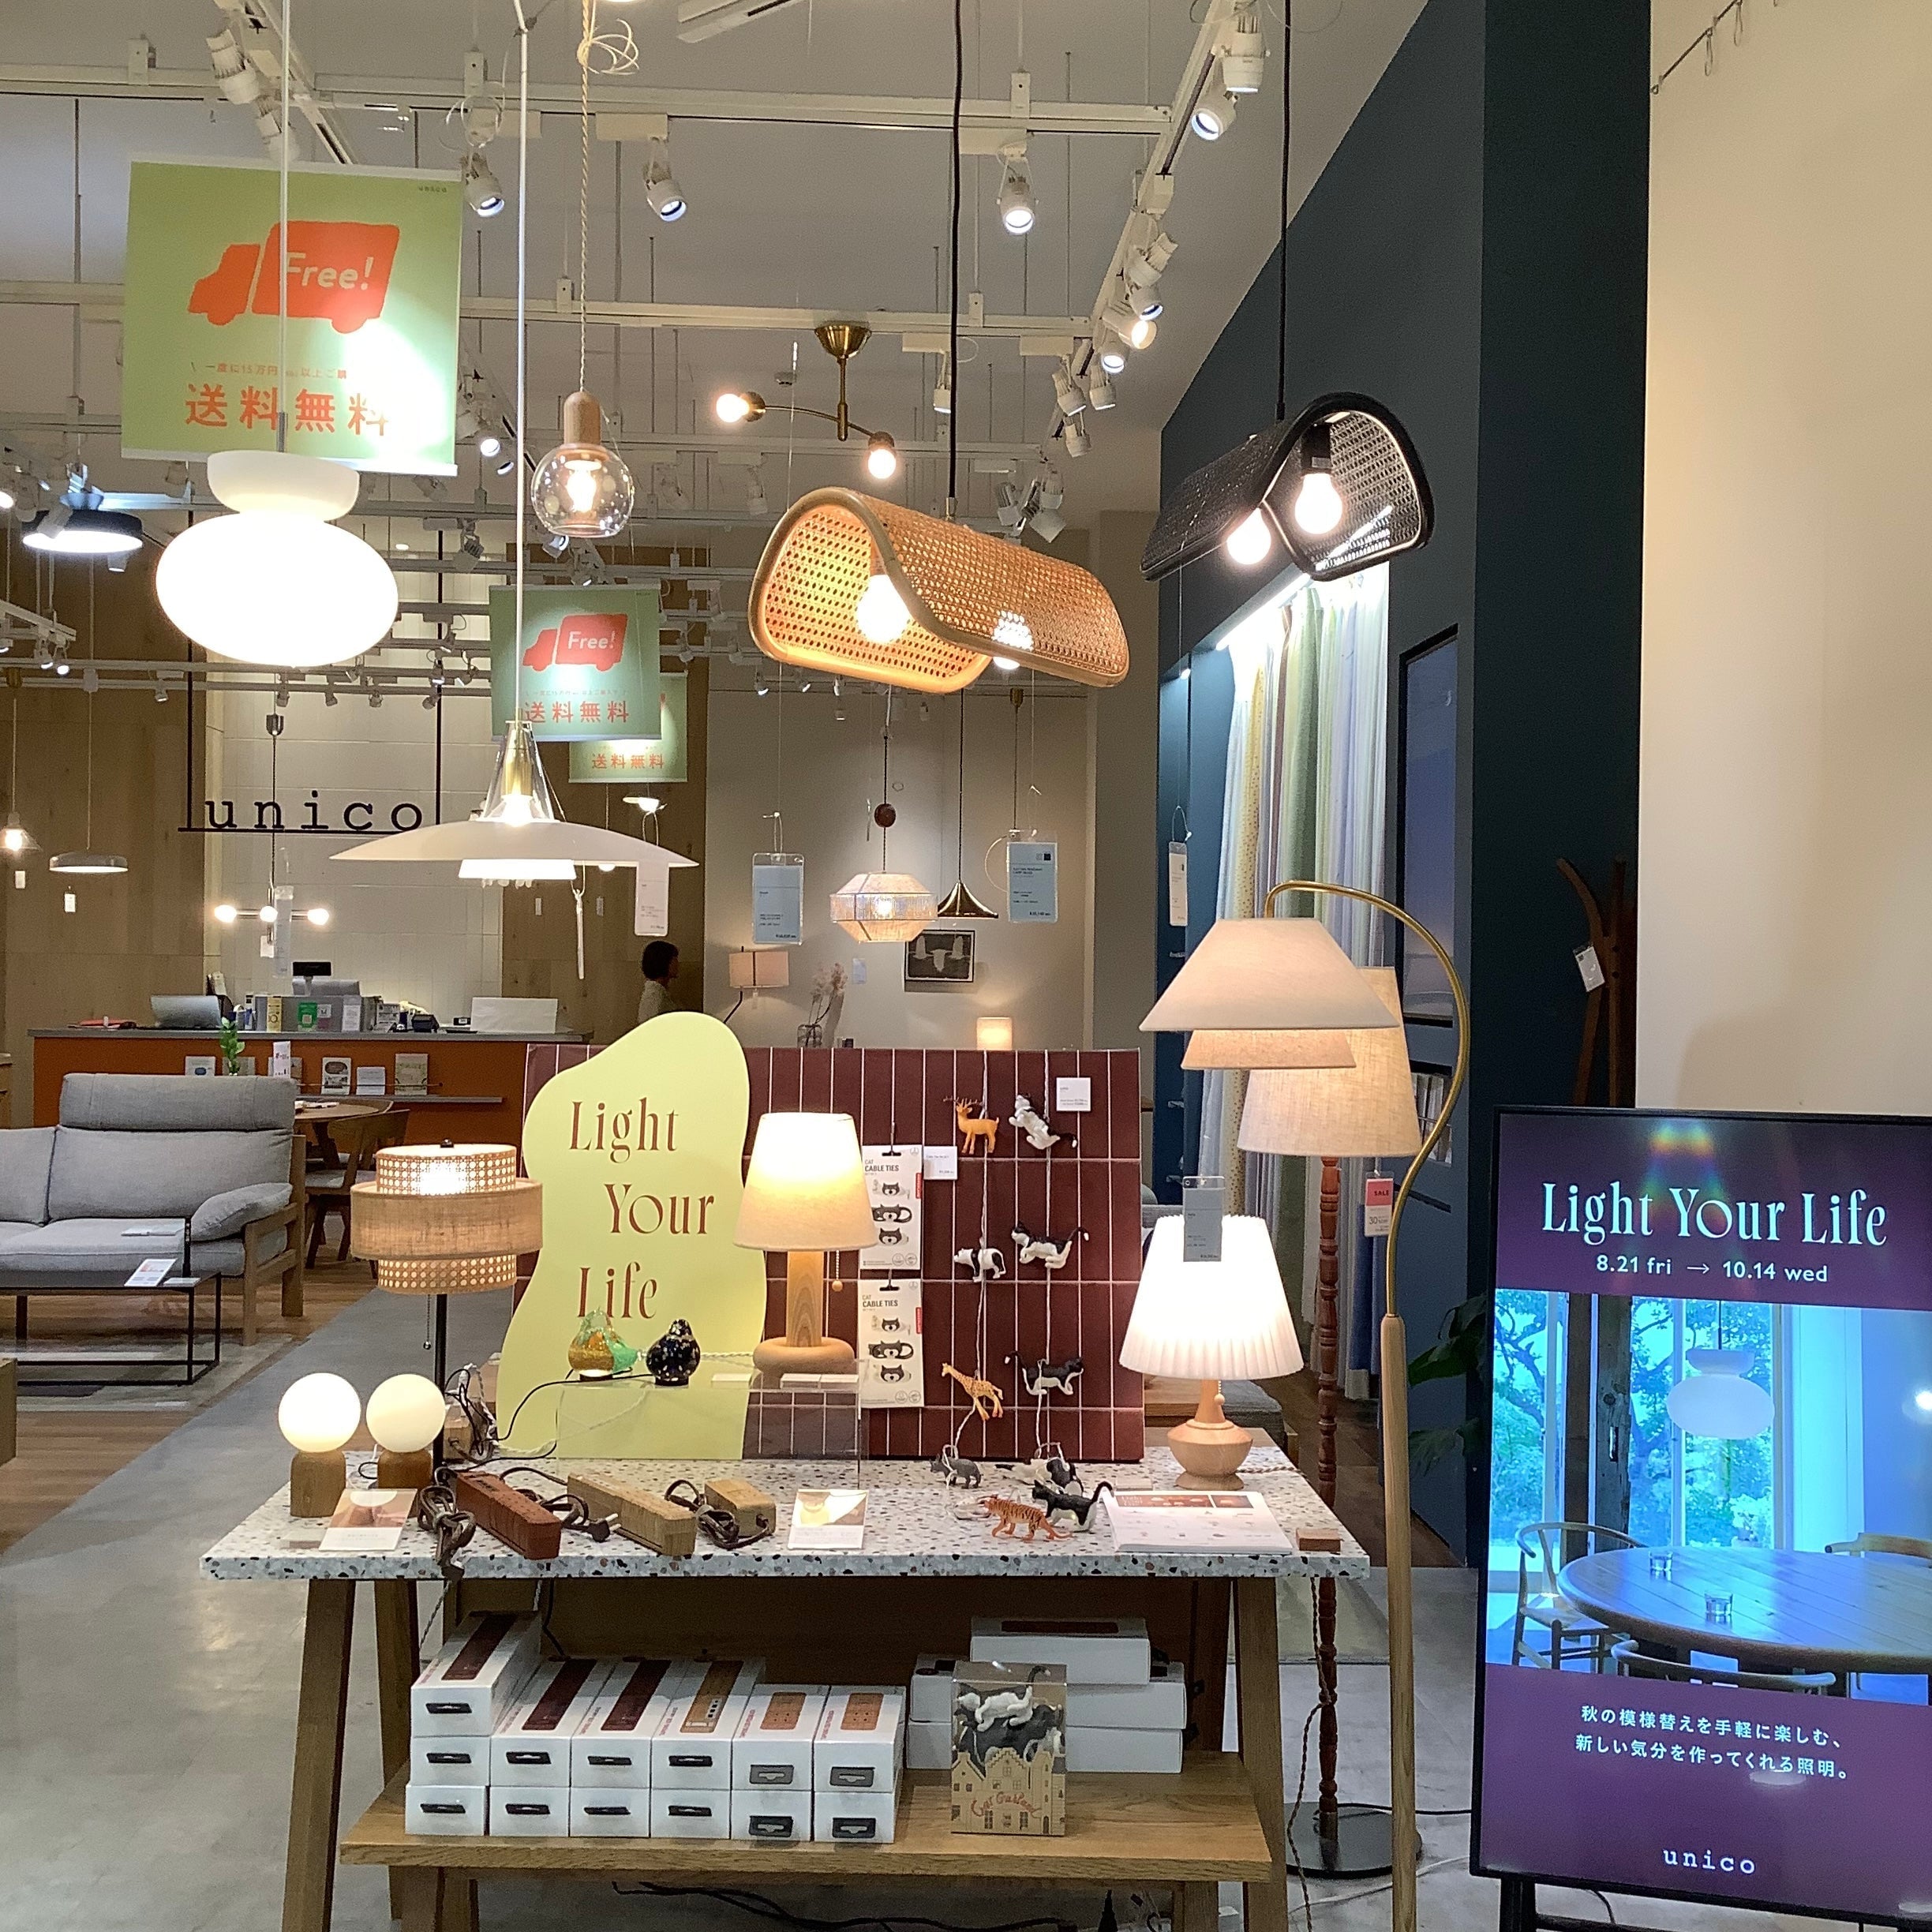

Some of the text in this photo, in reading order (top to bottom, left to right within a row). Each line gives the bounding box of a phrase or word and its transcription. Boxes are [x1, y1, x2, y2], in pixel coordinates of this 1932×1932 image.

[286, 252, 374, 290] Free!
[185, 384, 388, 436] 送料無料
[567, 631, 616, 649] Free!
[525, 701, 629, 724] 送料無料
[592, 754, 664, 769] 送料無料
[205, 790, 422, 832] unico
[569, 1097, 679, 1163] Light
[604, 1184, 714, 1234] Your
[1542, 1181, 1888, 1246] Light Your Life
[1597, 1254, 1829, 1282] 8.21 fri 10.14 wed
[577, 1261, 657, 1319] Life
[1581, 1705, 1840, 1749] 秋の模様替えを手軽に楽しむ、
[1575, 1734, 1847, 1779] 新しい気分を作ってくれる照明。
[1662, 1849, 1756, 1875] unico
